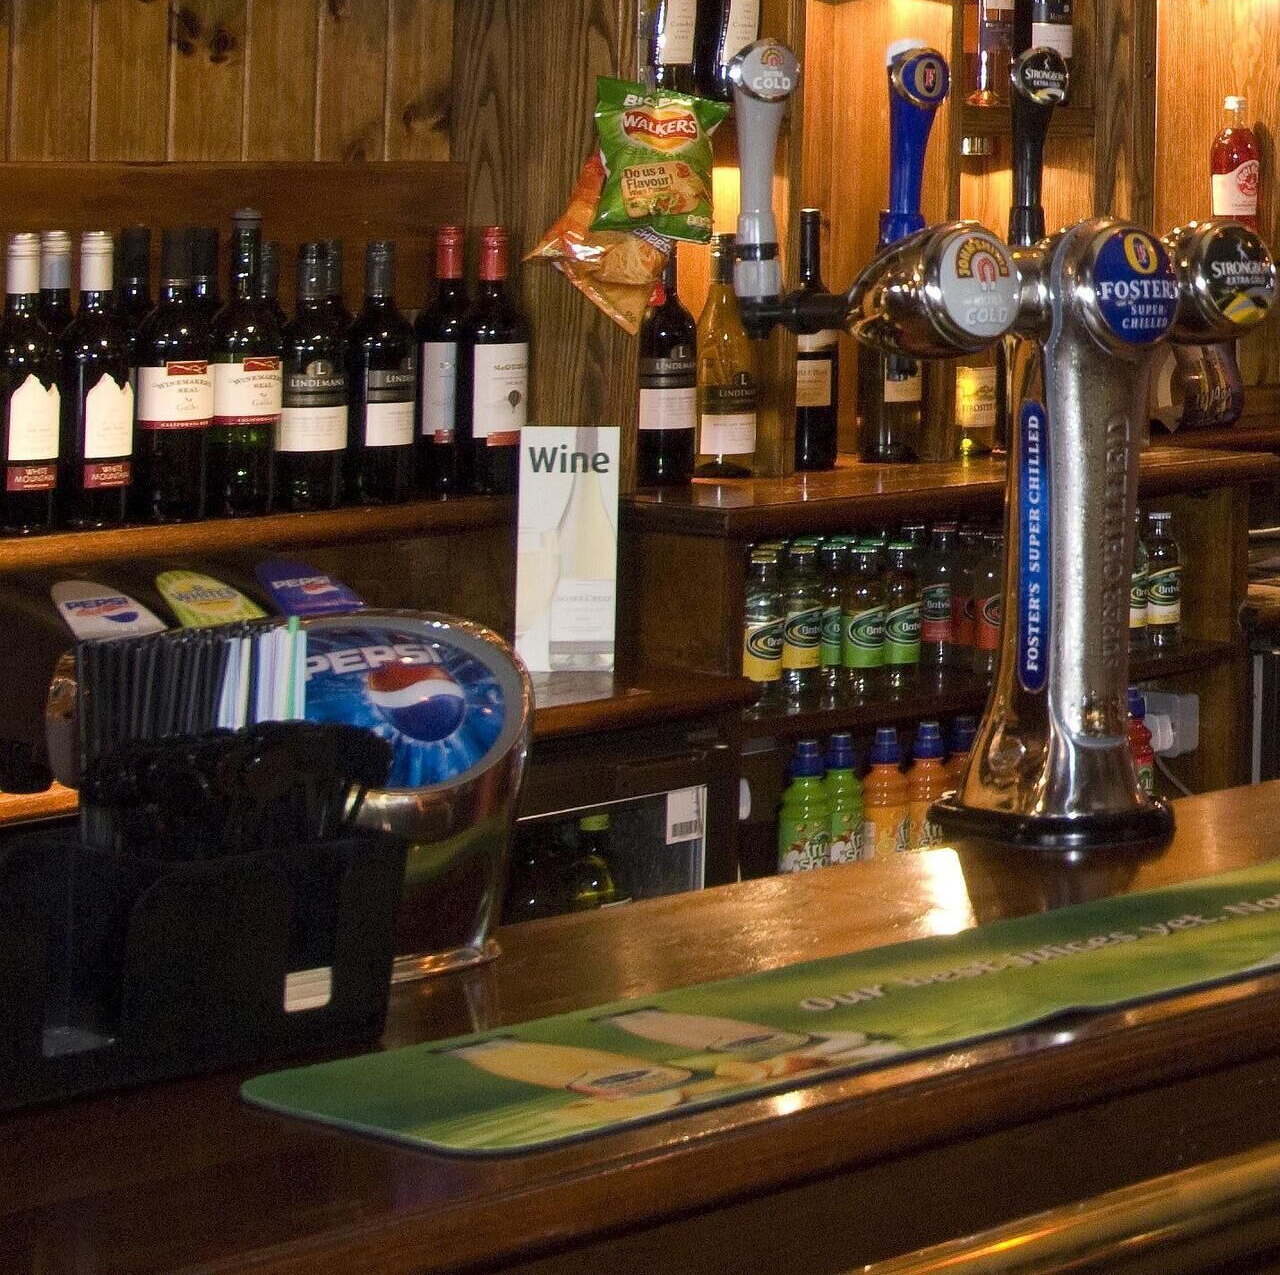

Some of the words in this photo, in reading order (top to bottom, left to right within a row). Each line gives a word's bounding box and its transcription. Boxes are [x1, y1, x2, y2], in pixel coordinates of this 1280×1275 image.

[752, 76, 792, 90] COLD
[623, 113, 697, 137] WALKERS
[624, 167, 640, 179] Do
[641, 166, 656, 176] us
[658, 166, 667, 175] a
[626, 174, 675, 191] Flavour!
[1211, 260, 1272, 278] STRONGBOW
[1099, 279, 1179, 301] FOSTER'S
[967, 308, 1009, 325] COLD
[1121, 317, 1169, 330] CHILLED
[289, 376, 345, 389] LINDEMANS
[528, 444, 611, 474] Wine
[1028, 415, 1041, 505] CHILLED
[1028, 512, 1041, 573] SUPER
[271, 575, 332, 590] PEPSI
[66, 596, 130, 612] PEPSI
[1027, 580, 1041, 672] FOSTER'S
[305, 642, 445, 682] PEPSI
[800, 982, 888, 1013] Our
